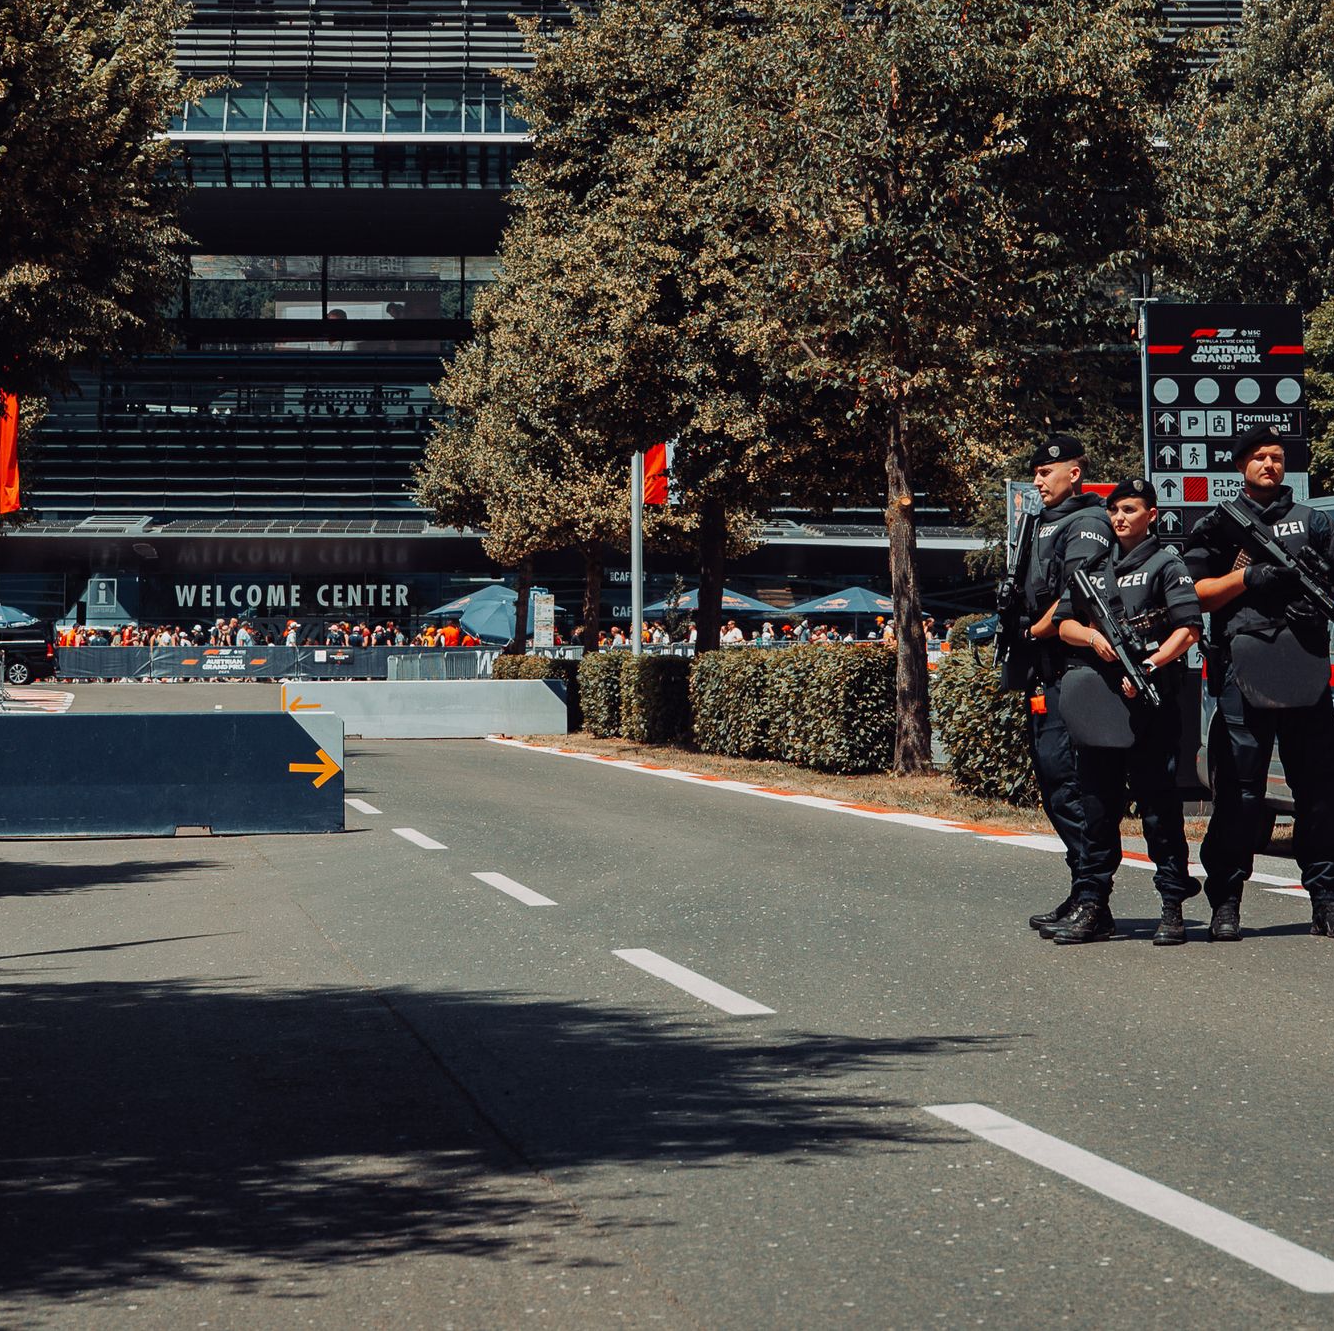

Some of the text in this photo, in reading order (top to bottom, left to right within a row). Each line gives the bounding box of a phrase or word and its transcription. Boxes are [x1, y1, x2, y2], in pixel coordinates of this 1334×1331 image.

[1196, 345, 1256, 354] AUSTRIAN
[1191, 354, 1261, 363] GRAND PRIX
[1236, 413, 1281, 422] Formula
[1213, 479, 1225, 487] F1
[1080, 531, 1110, 548] POLIZEI
[1089, 572, 1149, 590] POIZEI
[175, 584, 409, 607] WELCOME CENTER
